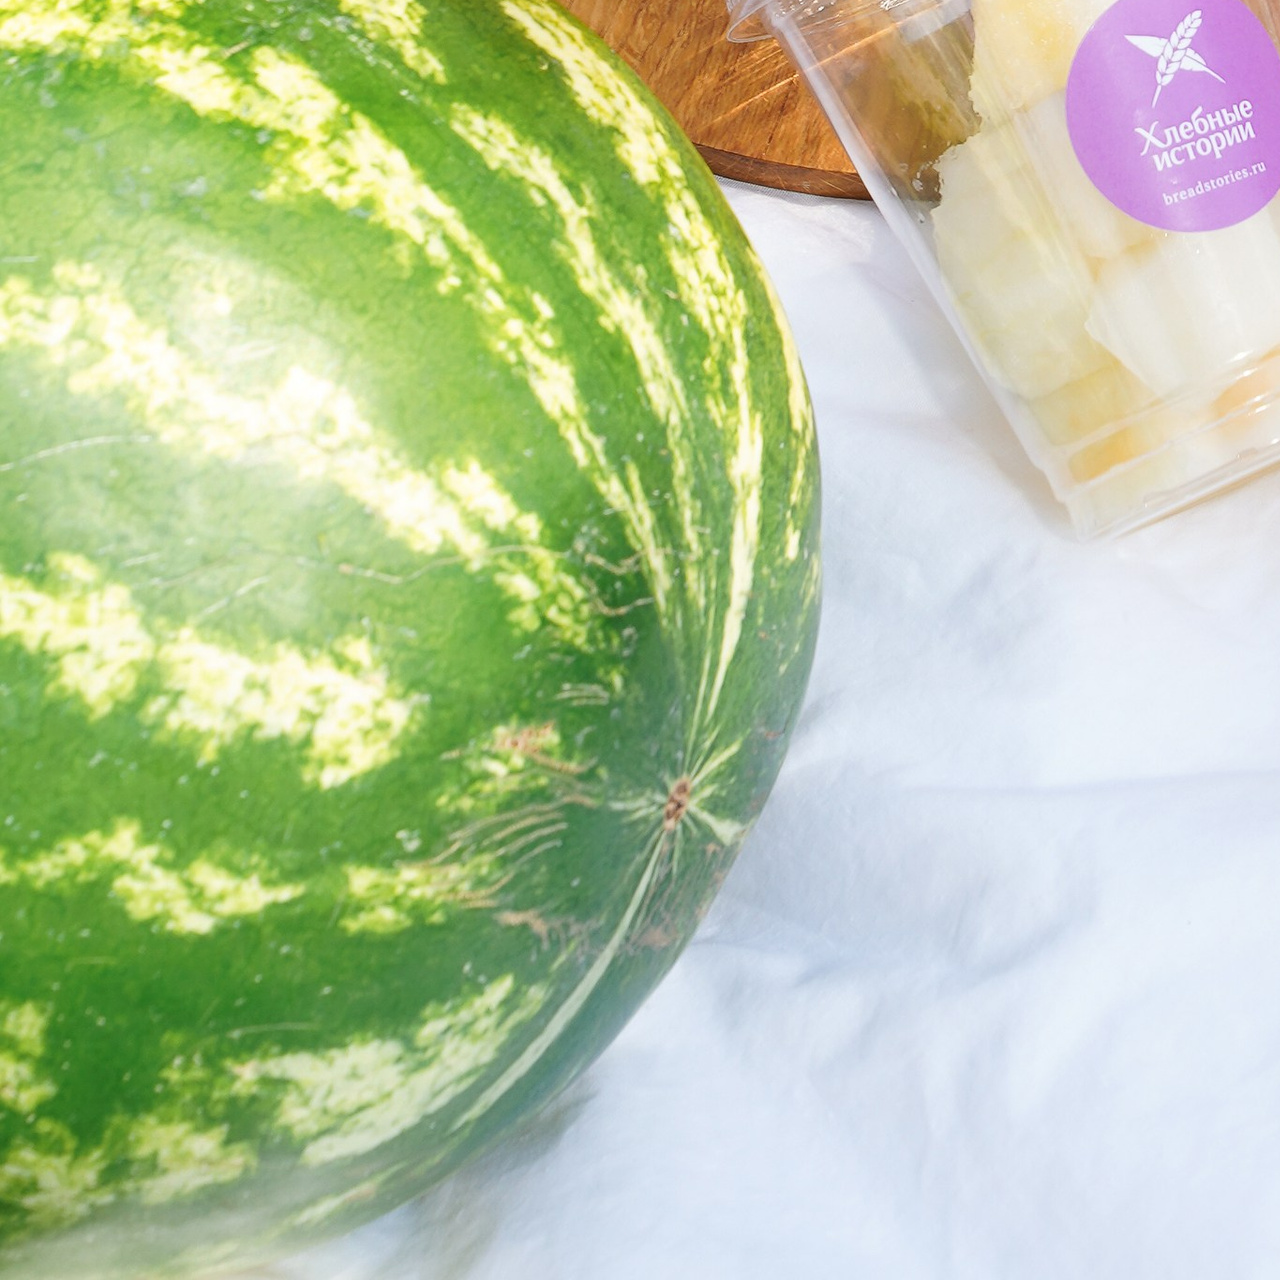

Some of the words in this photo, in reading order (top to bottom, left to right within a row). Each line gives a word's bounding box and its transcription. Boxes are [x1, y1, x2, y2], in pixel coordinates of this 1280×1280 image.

[1134, 99, 1254, 157] Хлебные
[1152, 121, 1257, 172] истории
[1162, 161, 1267, 206] breadstories.ru
